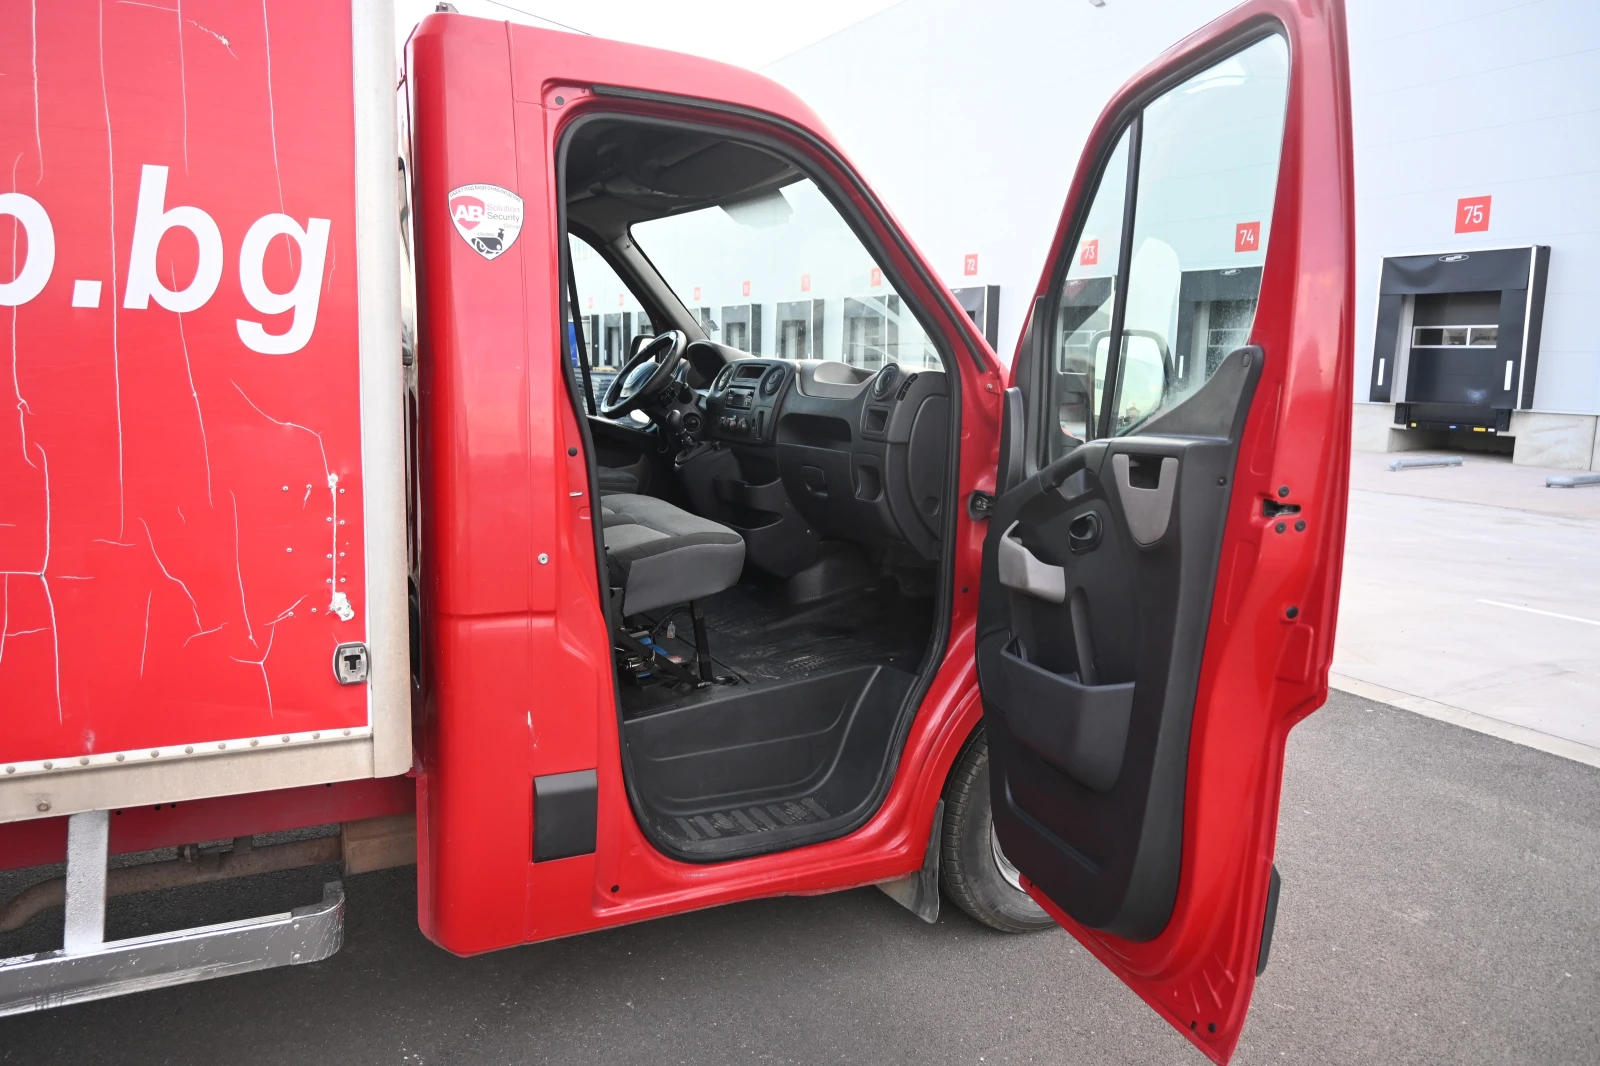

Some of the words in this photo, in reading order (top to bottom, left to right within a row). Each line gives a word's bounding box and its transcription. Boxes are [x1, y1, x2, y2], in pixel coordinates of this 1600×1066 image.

[487, 203, 520, 213] Solution
[1463, 204, 1484, 225] 75
[487, 212, 520, 223] Security
[1239, 228, 1255, 246] 74
[1084, 245, 1095, 260] 73
[966, 258, 976, 271] 72
